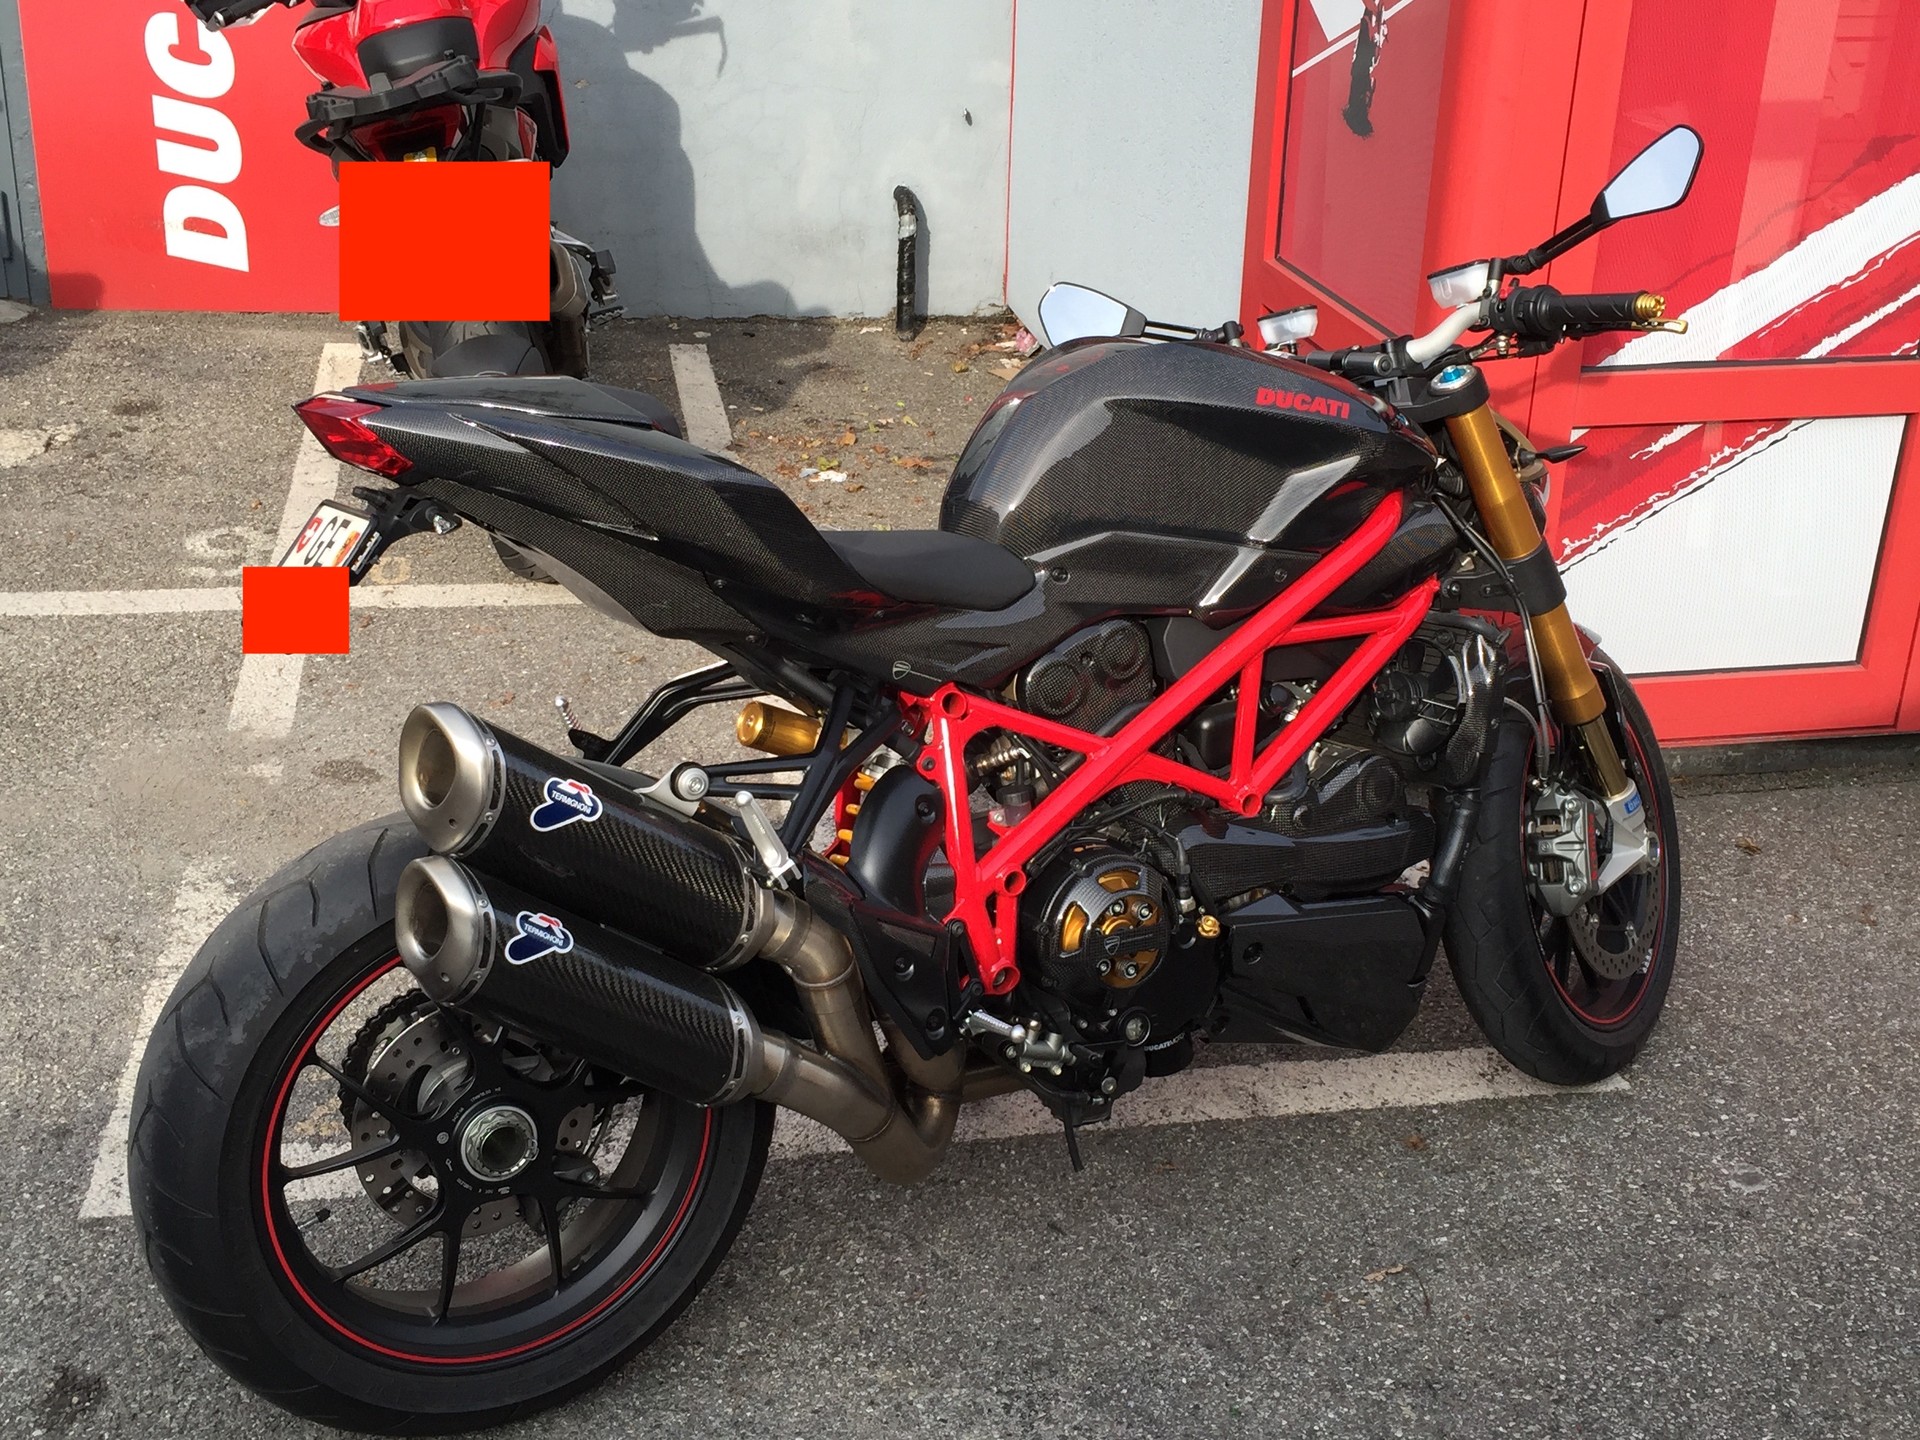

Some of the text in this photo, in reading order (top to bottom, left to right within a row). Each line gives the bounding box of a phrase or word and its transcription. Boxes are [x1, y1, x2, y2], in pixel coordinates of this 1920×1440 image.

[1255, 386, 1350, 419] DUCATI
[304, 516, 352, 567] GE
[551, 790, 592, 814] TERMIGNONI
[523, 923, 564, 947] TERMIGNONI
